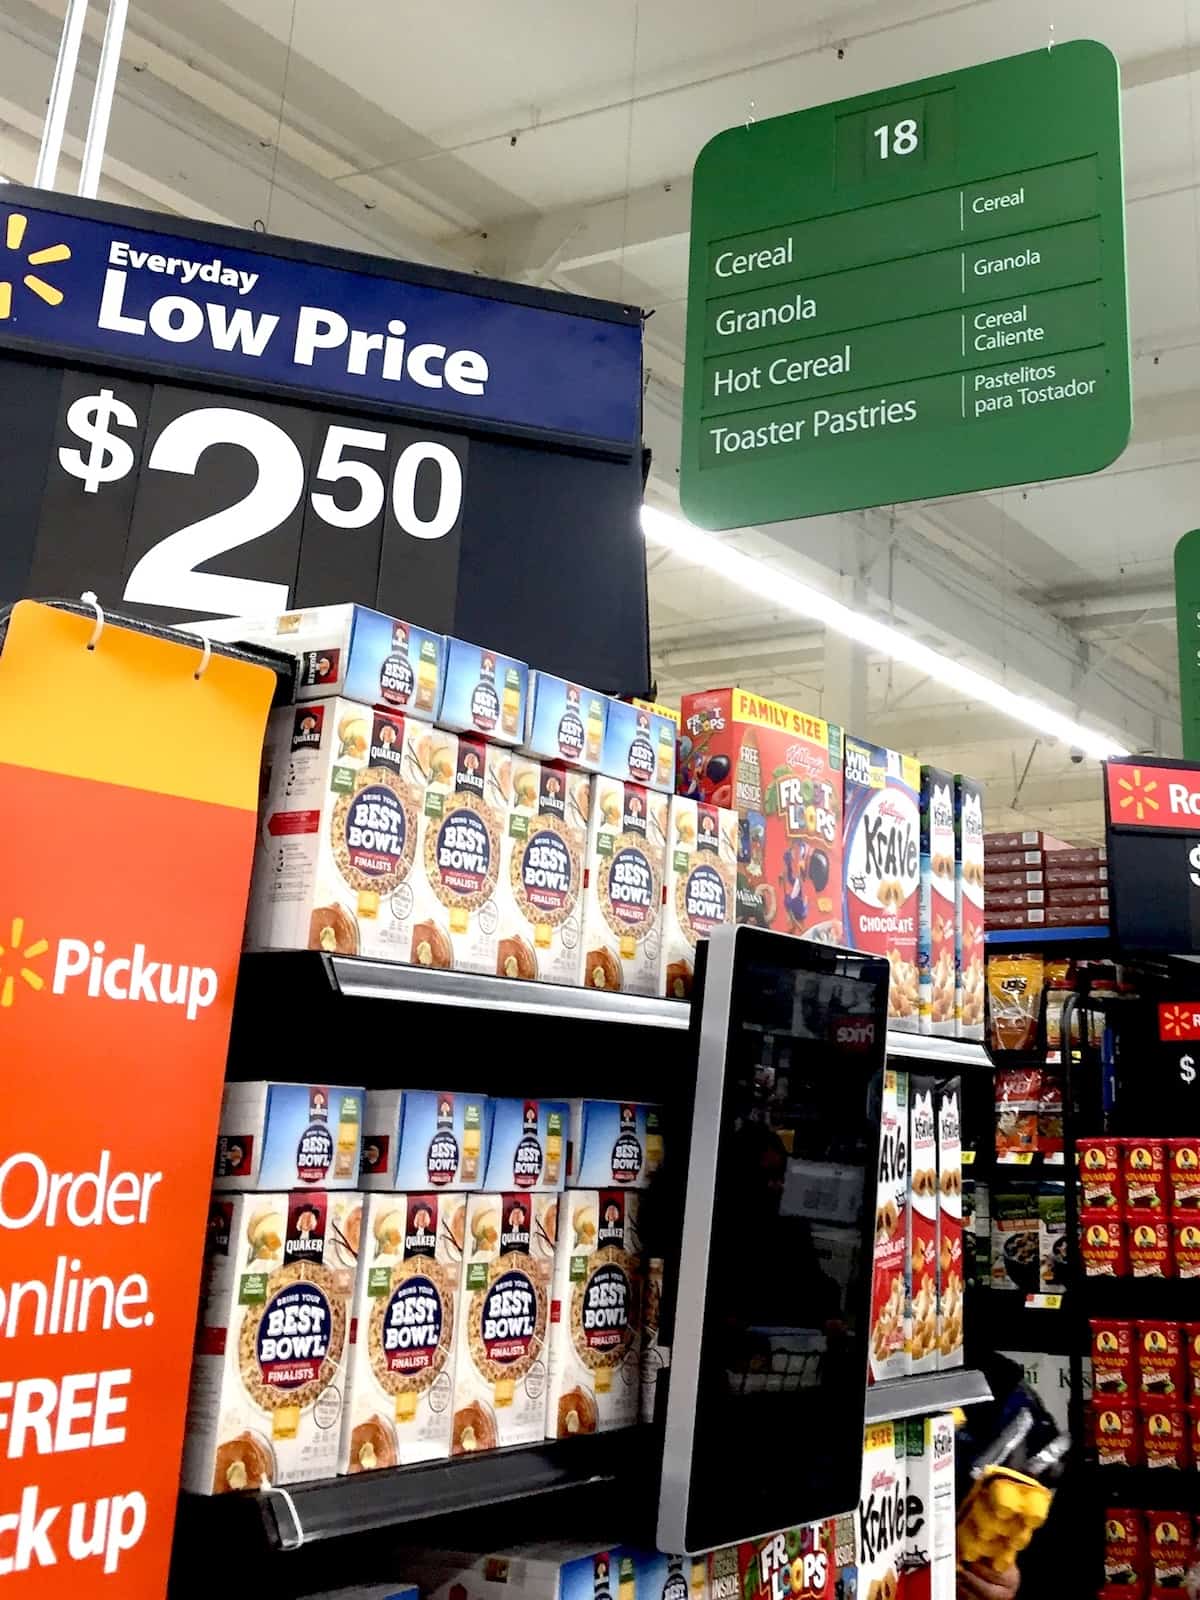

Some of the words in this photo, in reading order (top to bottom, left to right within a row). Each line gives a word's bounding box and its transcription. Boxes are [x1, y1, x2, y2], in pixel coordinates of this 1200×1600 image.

[873, 118, 919, 160] 18
[972, 187, 1025, 215] Cereal
[108, 240, 260, 295] Everyday
[714, 237, 794, 279] Cereal
[973, 249, 1041, 277] Granola
[715, 294, 817, 337] Granola
[973, 304, 1028, 331] Cereal
[96, 268, 281, 358] Low
[293, 306, 489, 396] Price
[974, 324, 1045, 352] Caliente
[713, 367, 761, 397] Hot
[768, 345, 852, 388] Cereal
[973, 364, 1056, 393] Pastelitos
[975, 392, 1013, 417] para
[1017, 378, 1097, 408] Tostador
[709, 416, 806, 456] Toaster
[813, 397, 918, 438] Pastries
[381, 676, 412, 694] BOWL
[383, 663, 412, 681] BEST
[740, 695, 789, 728] FAMILY
[792, 714, 821, 740] SIZE
[370, 745, 402, 764] QUAKER
[455, 772, 484, 789] QUAKER
[353, 802, 402, 832] BEST
[348, 826, 402, 856] BOWL
[444, 826, 486, 853] BEST
[353, 856, 393, 873] FINALISTS
[439, 847, 487, 874] BOWL
[528, 846, 568, 874] BEST
[443, 875, 480, 891] FINALISTS
[524, 867, 569, 892] BOWL
[614, 862, 650, 888] BEST
[611, 882, 651, 906] BOWL
[690, 879, 723, 902] BEST
[687, 898, 725, 919] BOWL
[859, 914, 914, 933] CHOCOLATE
[52, 938, 218, 1021] Pickup
[302, 1136, 331, 1153] BEST
[431, 1142, 457, 1158] BEST
[517, 1147, 540, 1162] BEST
[298, 1153, 331, 1168] BOWL
[429, 1158, 457, 1171] BOWL
[515, 1162, 540, 1175] BOWL
[0, 1150, 162, 1231] Order
[286, 1238, 324, 1254] QUAKER
[405, 1235, 436, 1250] QUAKER
[501, 1231, 530, 1245] QUAKER
[598, 1227, 624, 1239] QUAKER
[0, 1255, 154, 1339] nline.
[488, 1290, 533, 1318] BEST
[588, 1282, 626, 1308] BEST
[266, 1304, 326, 1337] BEST
[390, 1296, 438, 1326] BEST
[584, 1307, 628, 1329] BOWL
[385, 1324, 438, 1350] BOWL
[484, 1315, 534, 1340] BOWL
[589, 1334, 621, 1347] FINALISTS
[260, 1335, 326, 1362] BOWL
[490, 1345, 526, 1358] FINALISTS
[267, 1367, 315, 1382] FINALISTS
[391, 1356, 430, 1369] FINALISTS
[68, 1491, 147, 1574] up
